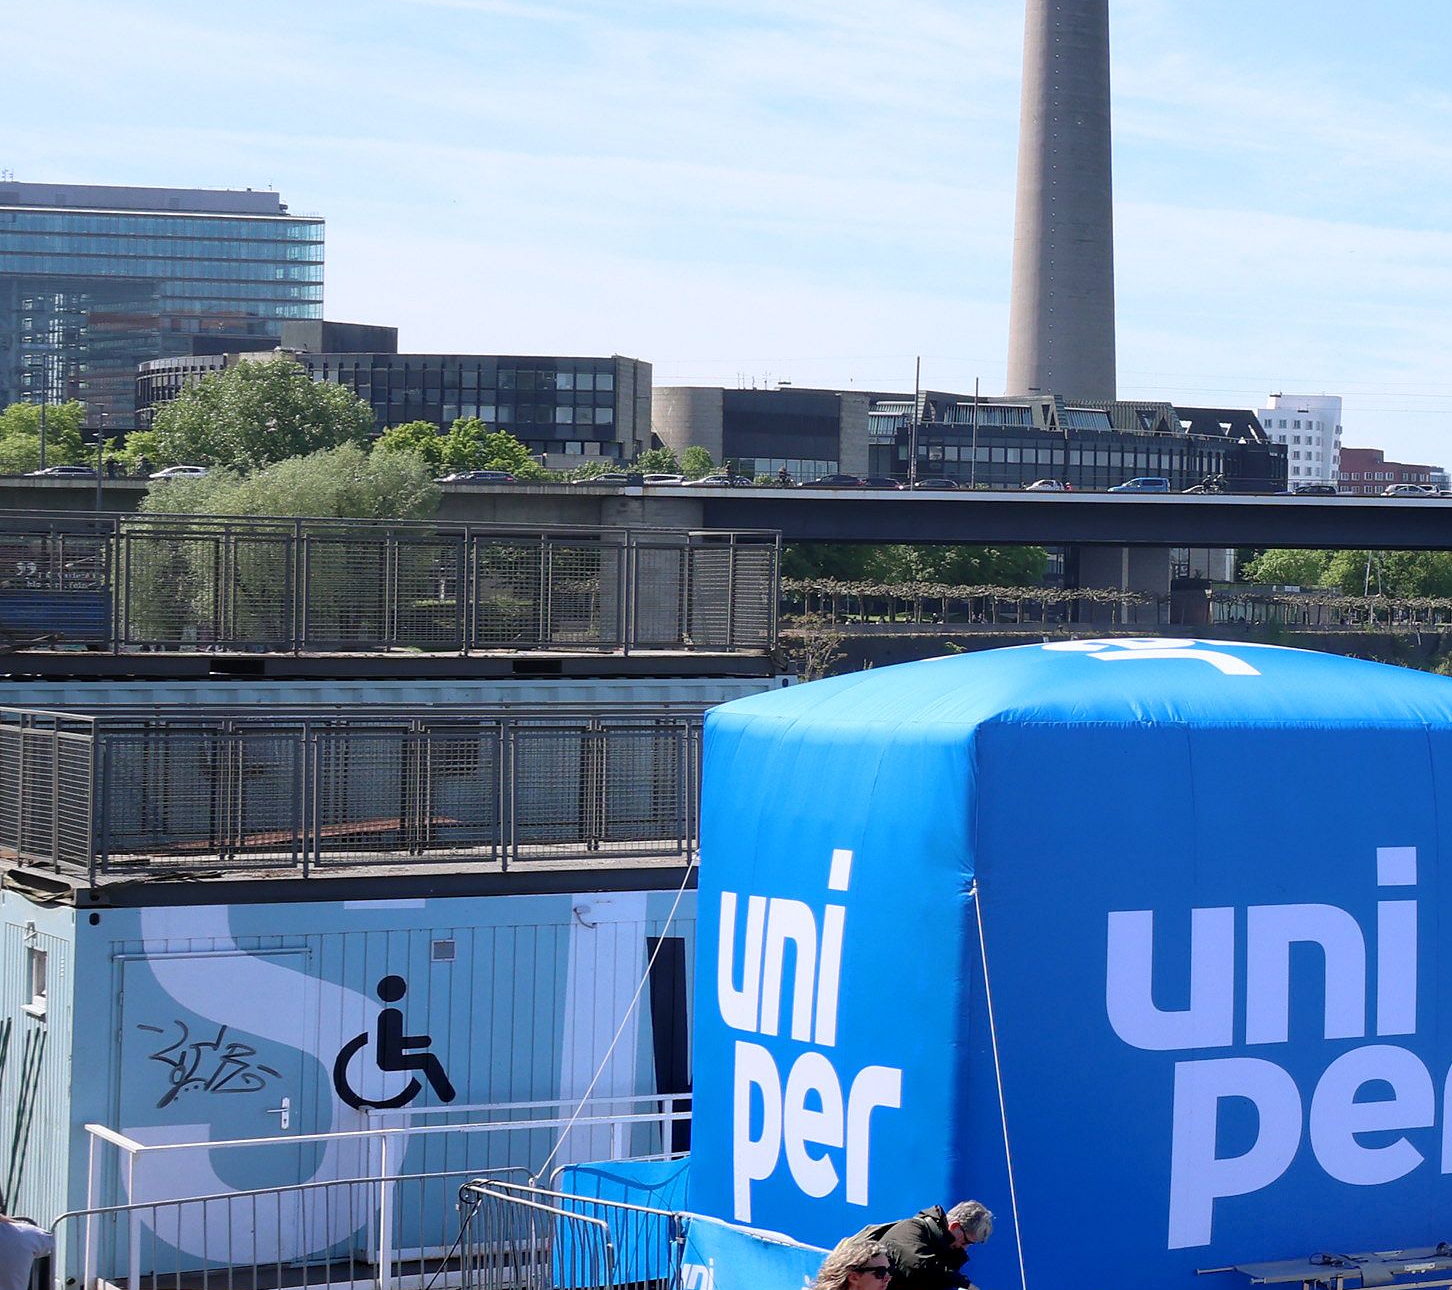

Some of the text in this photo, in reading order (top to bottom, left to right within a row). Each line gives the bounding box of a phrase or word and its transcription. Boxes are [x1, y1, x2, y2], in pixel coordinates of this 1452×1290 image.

[716, 848, 853, 1047] uni
[1105, 846, 1418, 1052] uni
[732, 1038, 904, 1225] per
